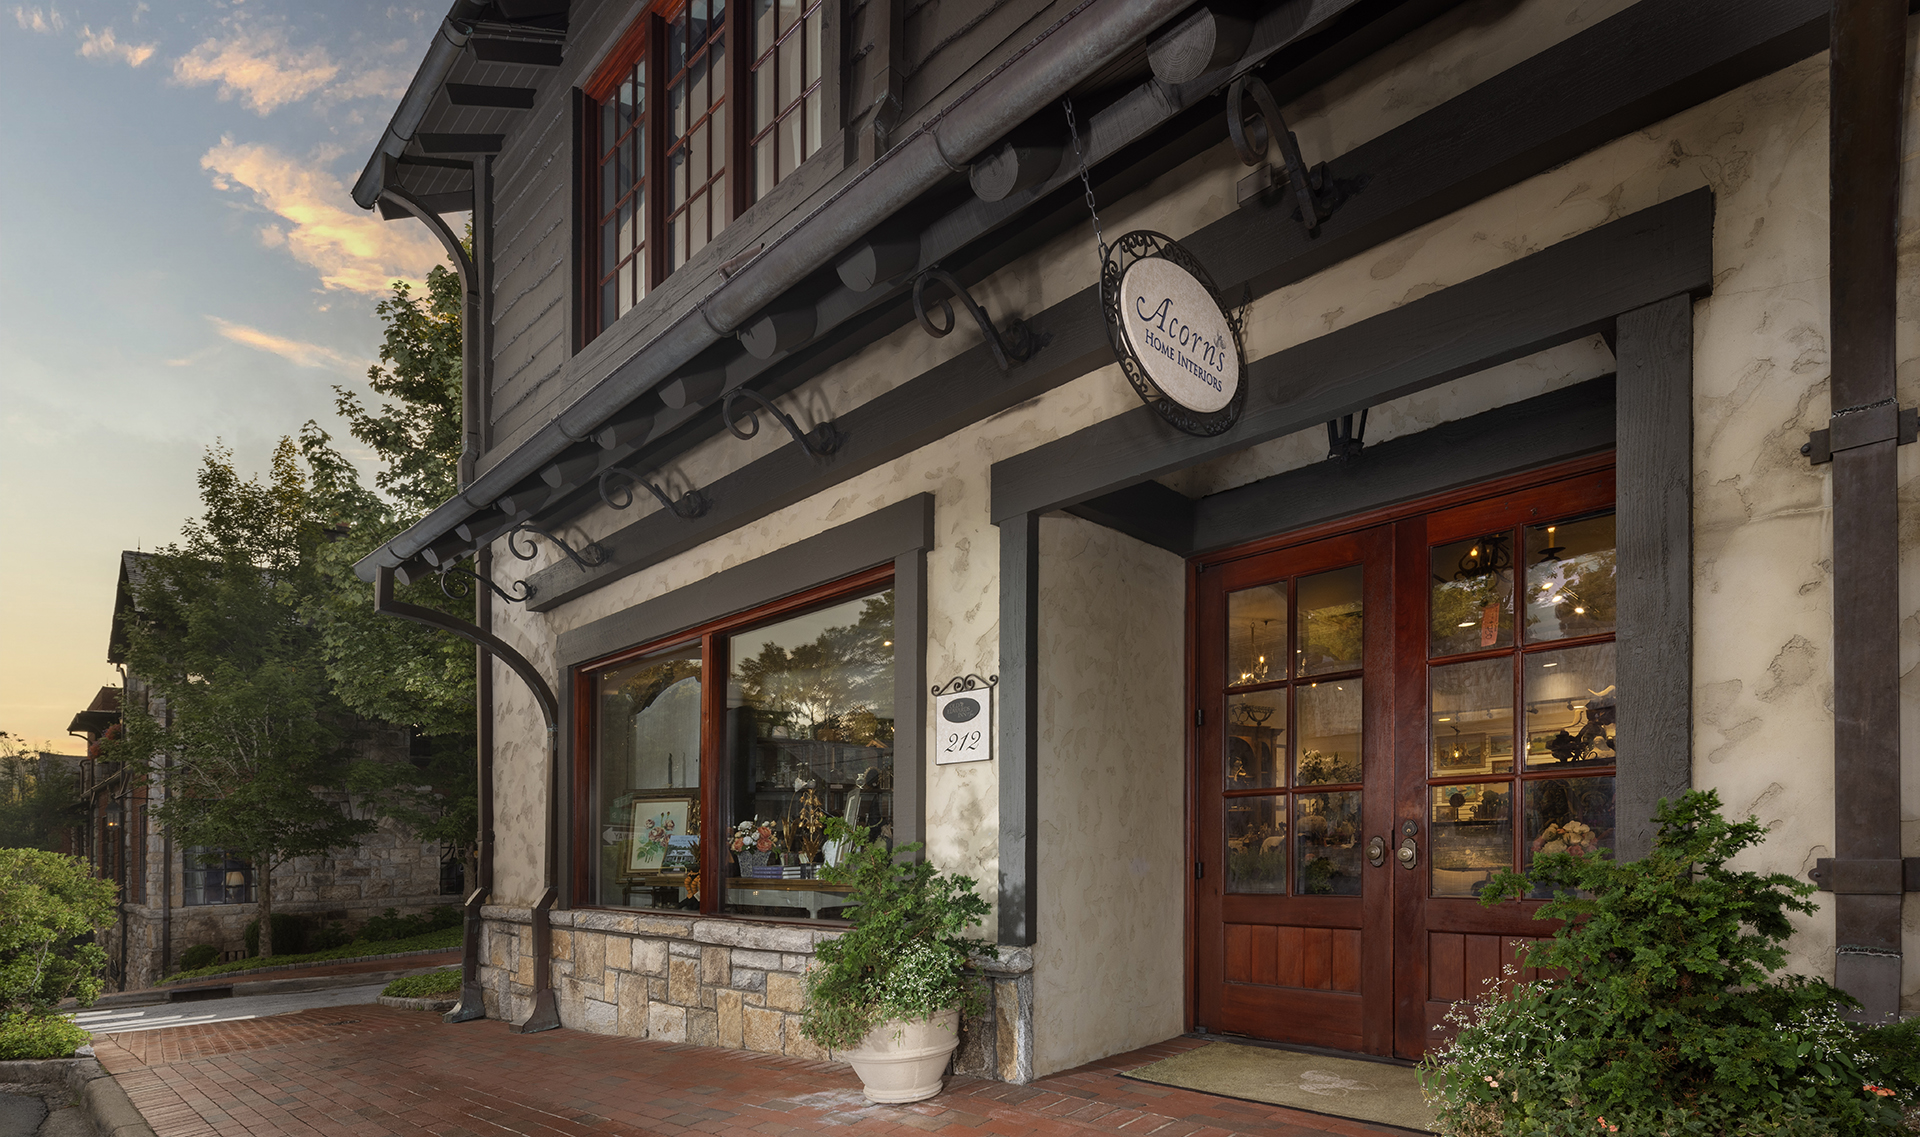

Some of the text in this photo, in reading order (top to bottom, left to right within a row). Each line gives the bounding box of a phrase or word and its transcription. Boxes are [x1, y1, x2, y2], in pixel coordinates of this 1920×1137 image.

[1136, 296, 1225, 372] Acorns
[1145, 329, 1223, 392] HOME INTERIORS
[944, 731, 981, 752] 212
